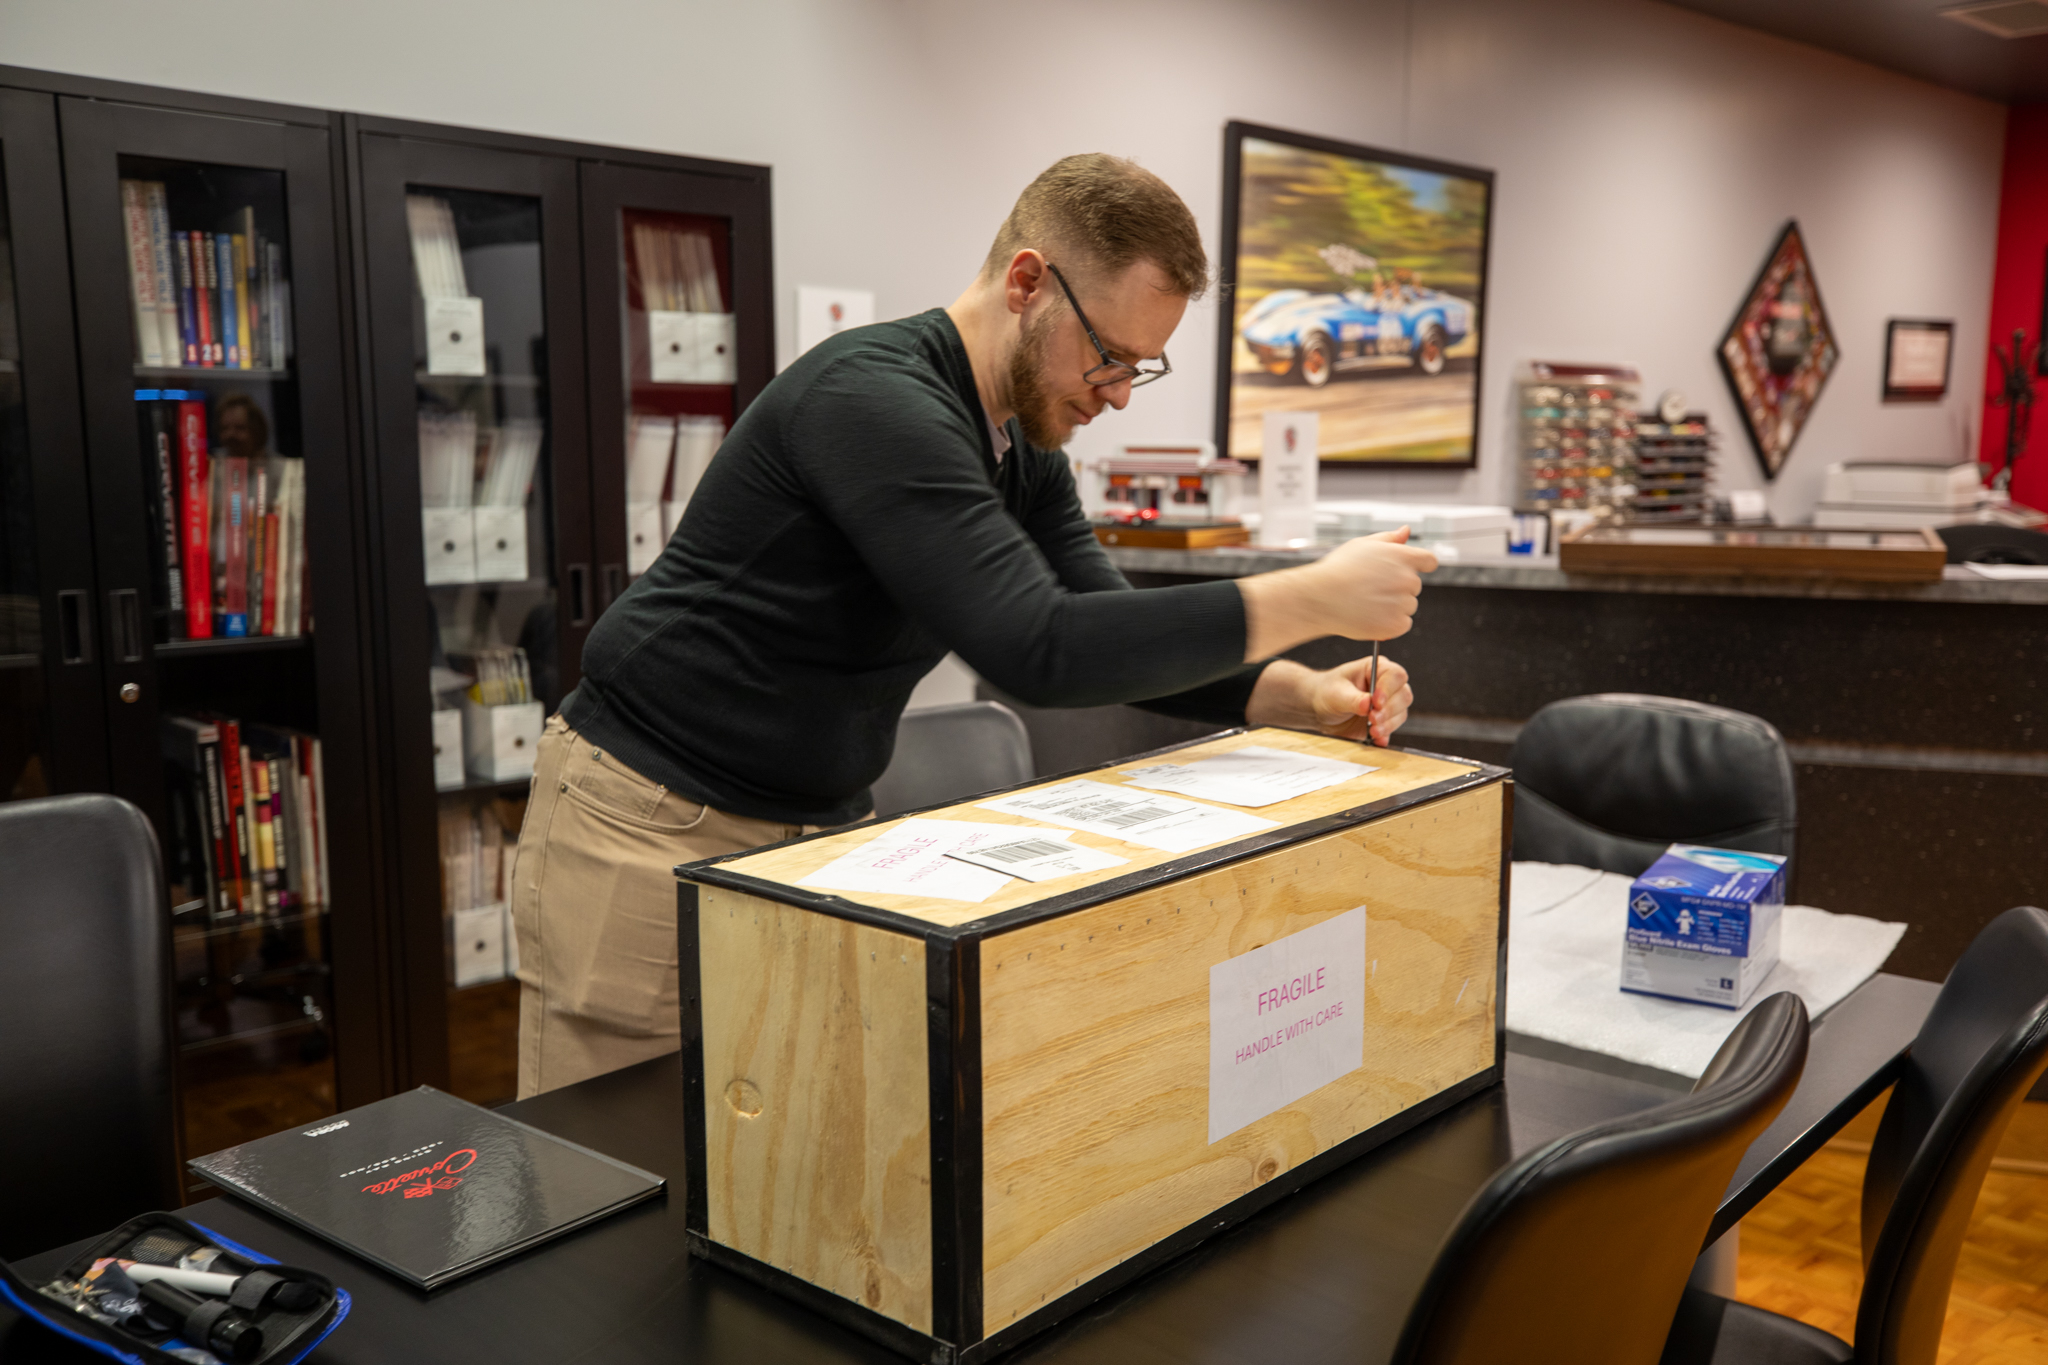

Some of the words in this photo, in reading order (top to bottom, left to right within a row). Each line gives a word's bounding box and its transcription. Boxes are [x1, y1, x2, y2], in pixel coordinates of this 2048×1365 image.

[202, 344, 212, 361] 2
[187, 414, 202, 546] CORVETTE
[871, 837, 939, 869] FRAGILE
[1628, 934, 1648, 943] Blue
[1649, 936, 1675, 947] Nitrile
[1676, 940, 1700, 950] Exam
[1701, 943, 1732, 956] Gloves
[1258, 966, 1326, 1016] FRAGILE
[1235, 1029, 1283, 1065] HANDLE
[1284, 1015, 1313, 1041] WITH
[1315, 1001, 1343, 1027] CARE
[361, 1148, 477, 1195] Corvette
